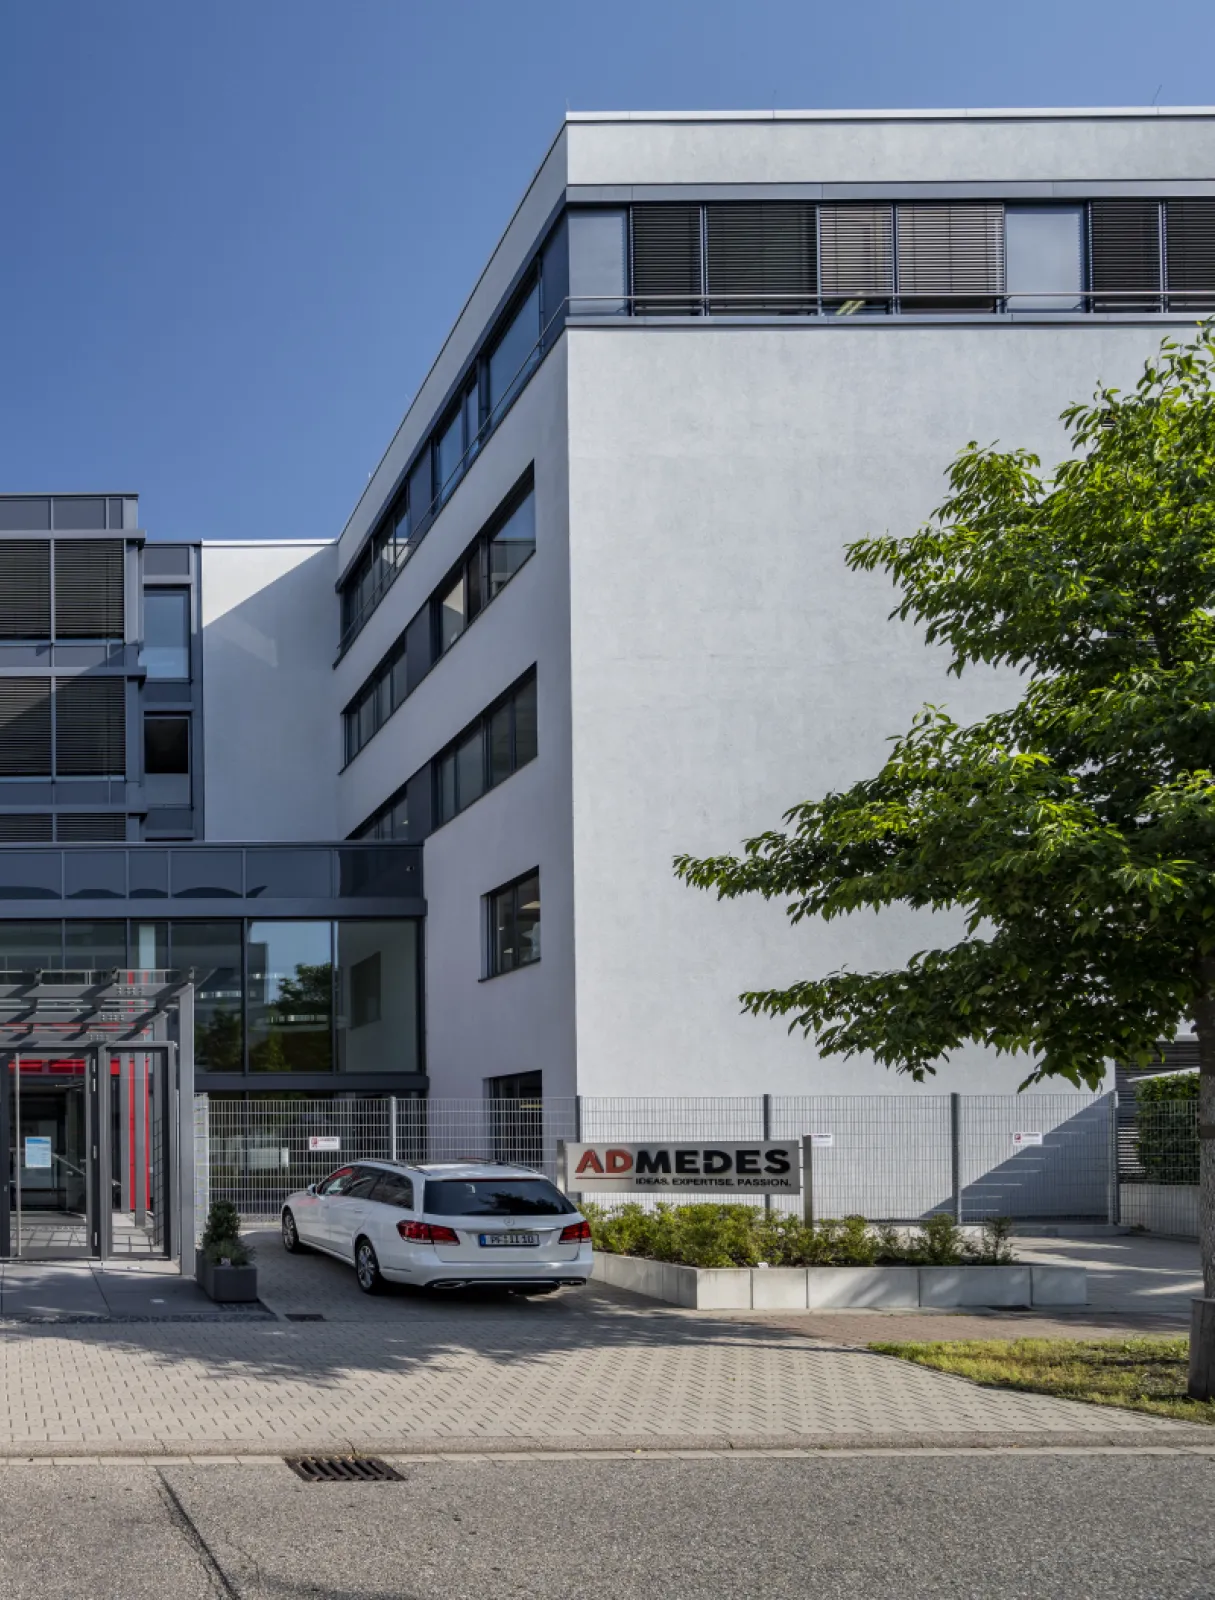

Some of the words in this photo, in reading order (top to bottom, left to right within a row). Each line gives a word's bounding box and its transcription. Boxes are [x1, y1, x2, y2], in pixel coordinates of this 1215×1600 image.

[574, 1148, 791, 1174] ADMEDES
[635, 1177, 669, 1185] IDEAS.
[672, 1178, 734, 1187] EXPERTISE.
[737, 1178, 792, 1187] PASSION.
